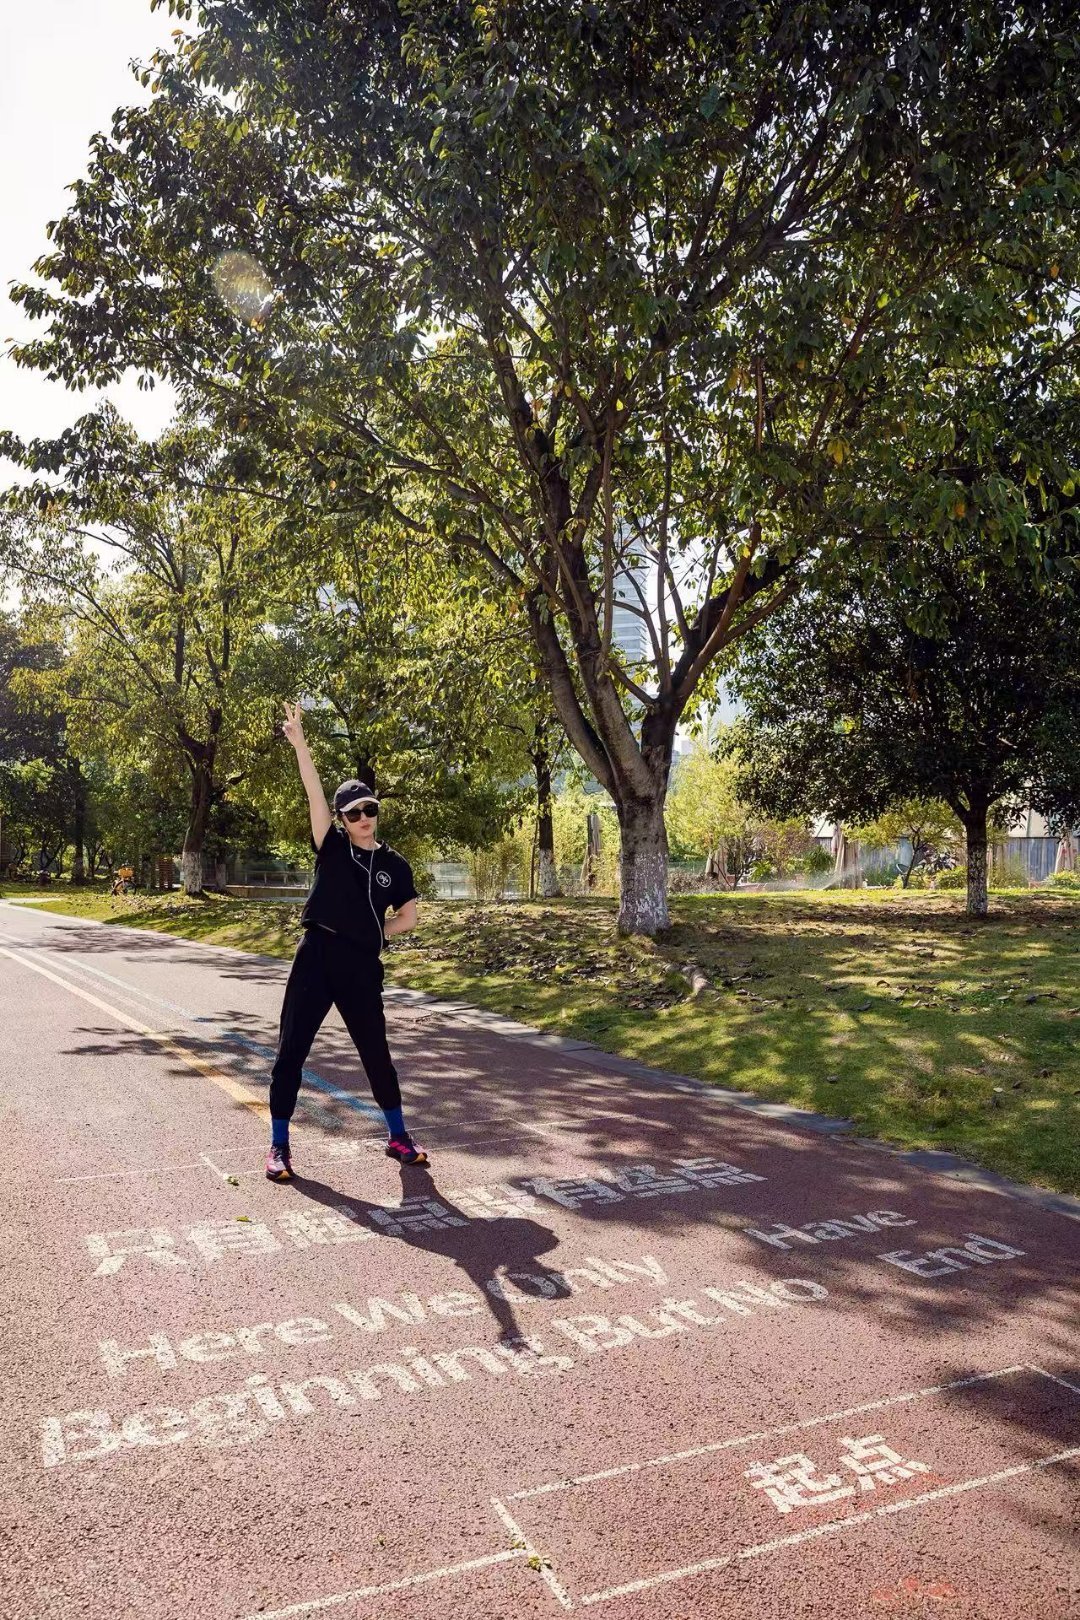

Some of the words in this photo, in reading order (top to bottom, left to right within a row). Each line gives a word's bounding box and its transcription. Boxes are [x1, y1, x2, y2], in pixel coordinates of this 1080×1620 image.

[84, 1156, 768, 1275] 只有起点没有终点
[40, 1334, 574, 1469] Beginning
[552, 1297, 726, 1353] But
[702, 1278, 829, 1317] No
[876, 1233, 1028, 1279] End
[98, 1316, 334, 1378] Here
[331, 1291, 487, 1333] We
[743, 1210, 918, 1250] Have
[743, 1434, 932, 1513] 起点
